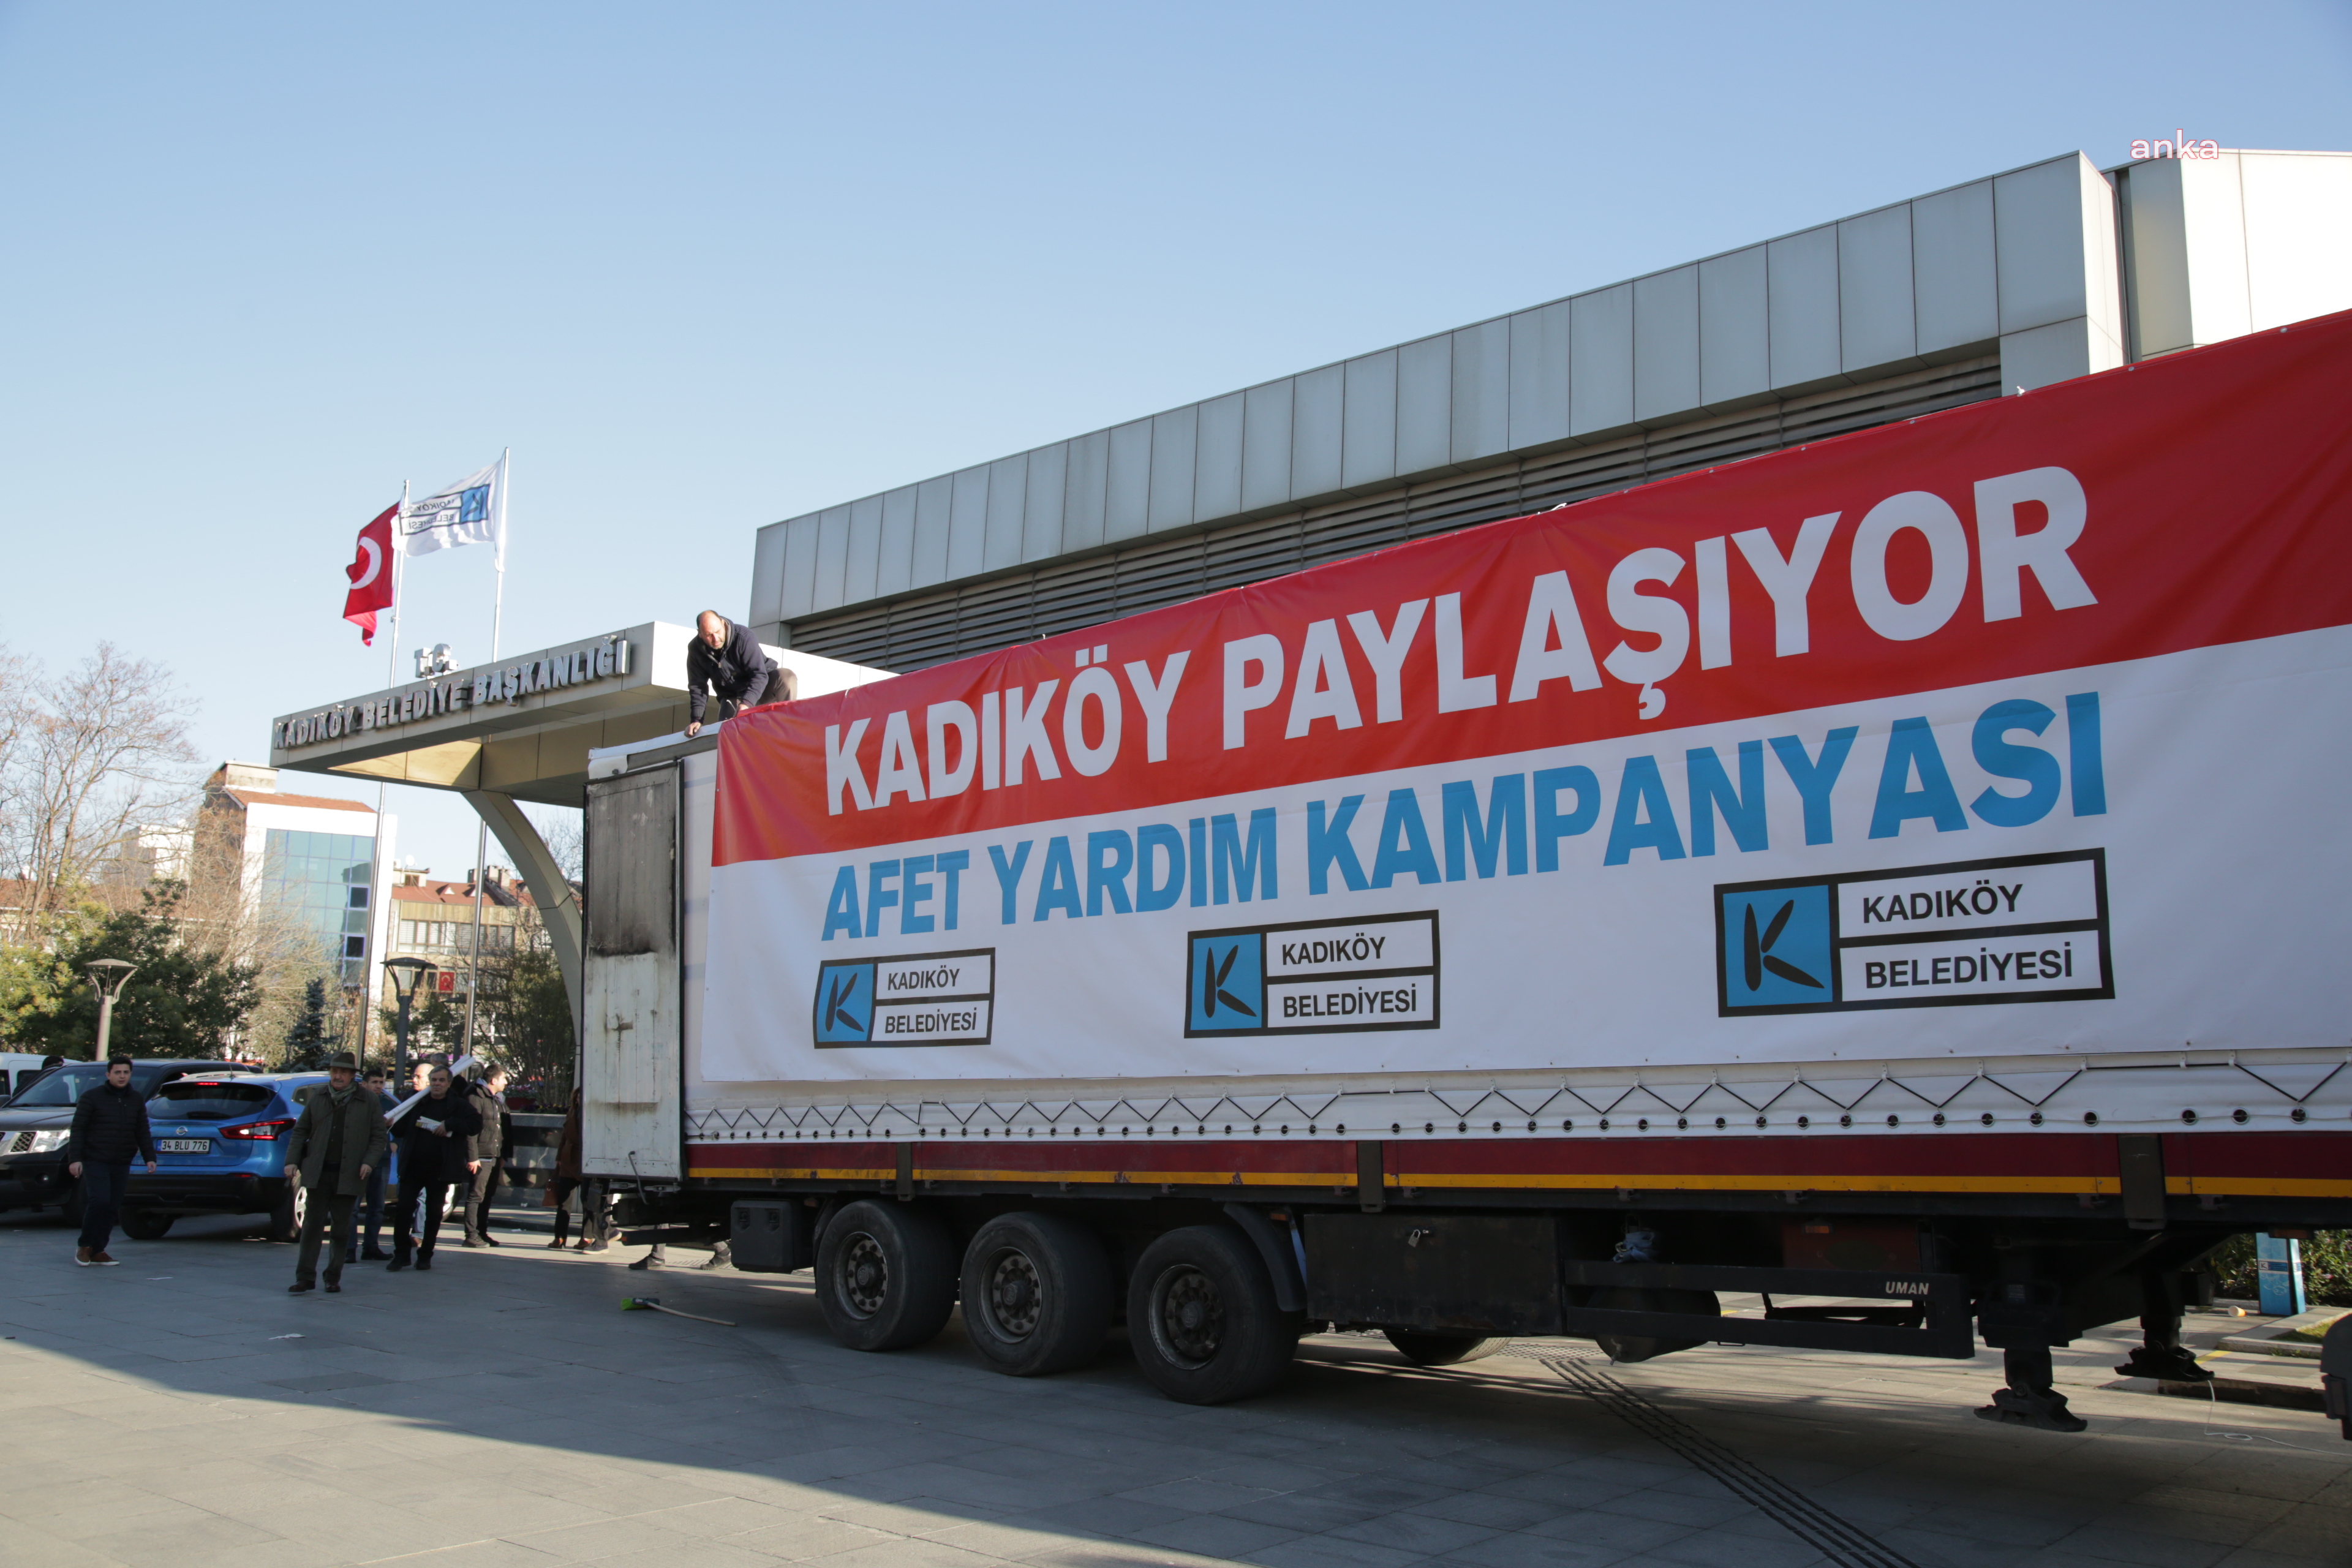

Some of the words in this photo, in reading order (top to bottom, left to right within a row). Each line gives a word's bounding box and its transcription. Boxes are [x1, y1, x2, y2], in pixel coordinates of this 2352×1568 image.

[824, 644, 1191, 816] KADIKÖY
[1223, 466, 2098, 750] PAYLAŞIYOR
[274, 704, 358, 749] KADIKÖY
[363, 680, 467, 731] BELEDİYE
[473, 635, 630, 707] BAŞKANLIĞI
[821, 850, 970, 941] AFET
[987, 807, 1278, 925] YARDIM
[1306, 691, 2107, 896] KAMPANYASI
[1863, 879, 2023, 924] KADIKÖY
[1282, 932, 1386, 966] KADIKÖY
[1865, 941, 2073, 989] BELEDİYESİ
[887, 965, 960, 990] KADIKÖY
[1283, 983, 1417, 1018] BELEDİYESİ
[884, 1007, 977, 1034] BELEDİYESİ
[162, 1140, 171, 1150] 34
[175, 1140, 190, 1150] BLU
[192, 1140, 208, 1150] 776
[1885, 1281, 1929, 1295] UMAN
